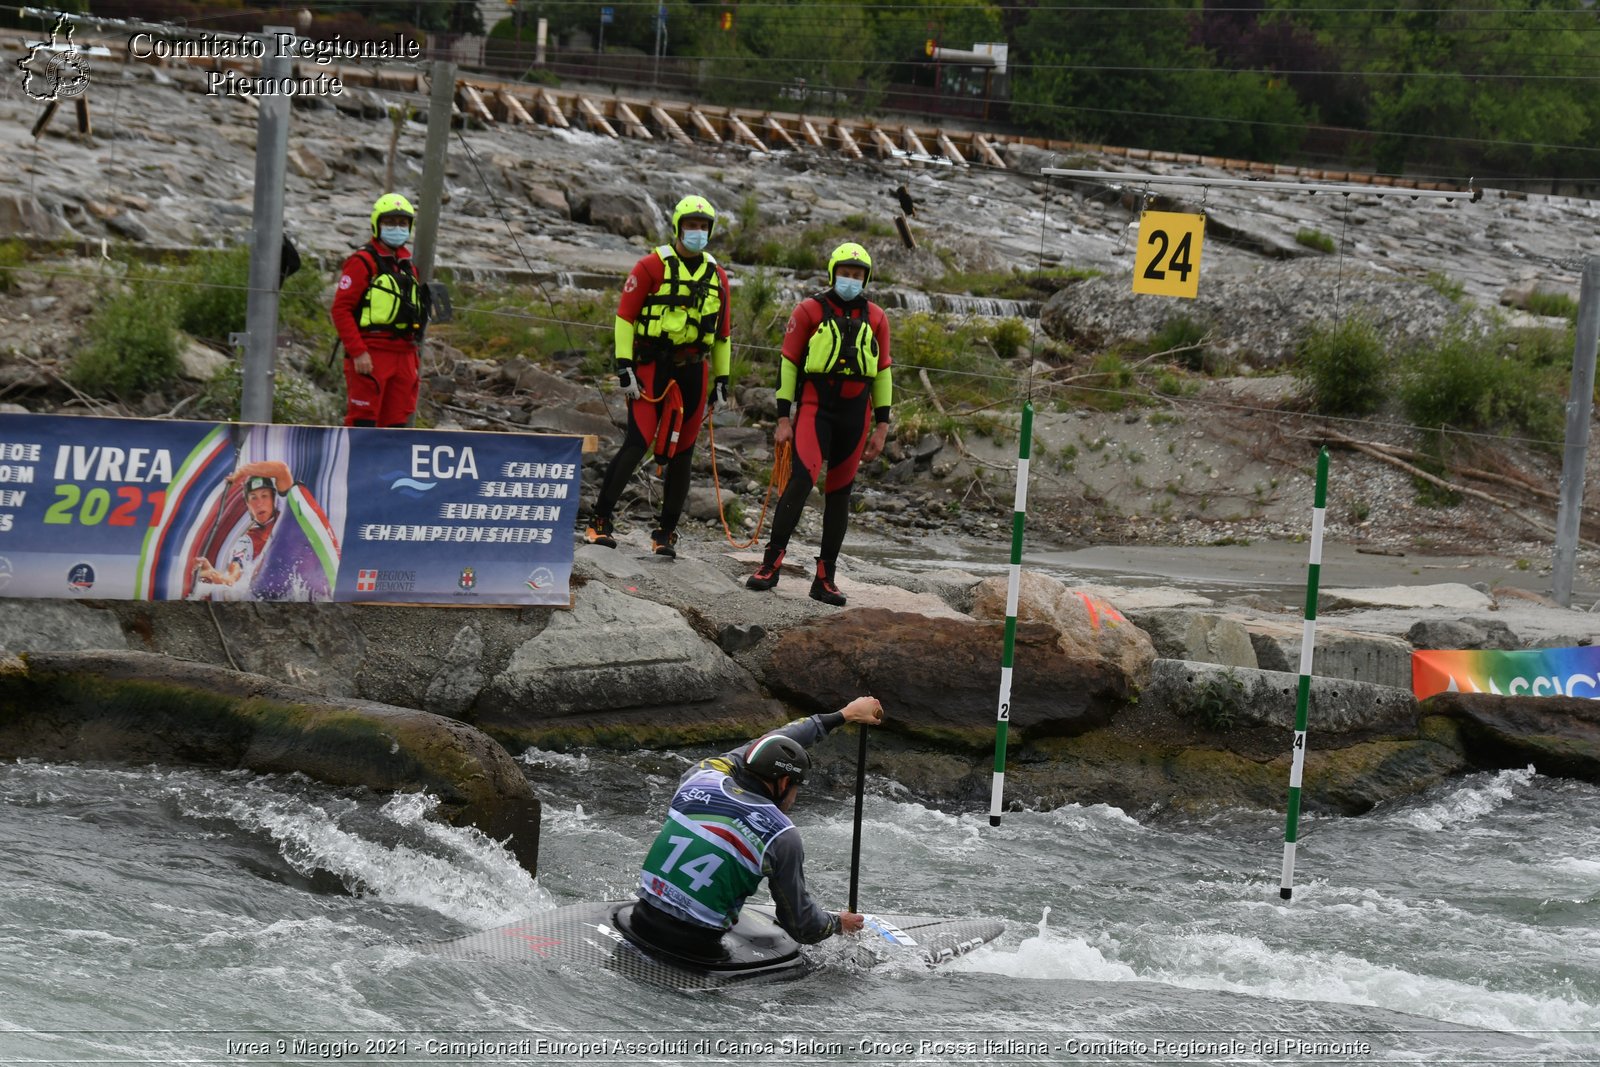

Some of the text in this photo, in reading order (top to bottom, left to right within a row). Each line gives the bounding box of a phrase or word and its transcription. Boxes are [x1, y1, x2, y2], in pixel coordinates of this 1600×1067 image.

[1143, 229, 1193, 282] 24
[53, 445, 173, 483] IVREA
[411, 444, 479, 480] ECA
[504, 461, 576, 480] CANOE
[481, 481, 568, 499] SLALOM
[43, 484, 168, 527] 2021
[442, 503, 561, 521] EUROPEAN
[360, 524, 554, 544] CHAMPIONSHIPS
[377, 570, 417, 582] REGIONE
[374, 581, 416, 592] PIEMONTE
[688, 787, 712, 805] ECA
[660, 835, 725, 892] 14
